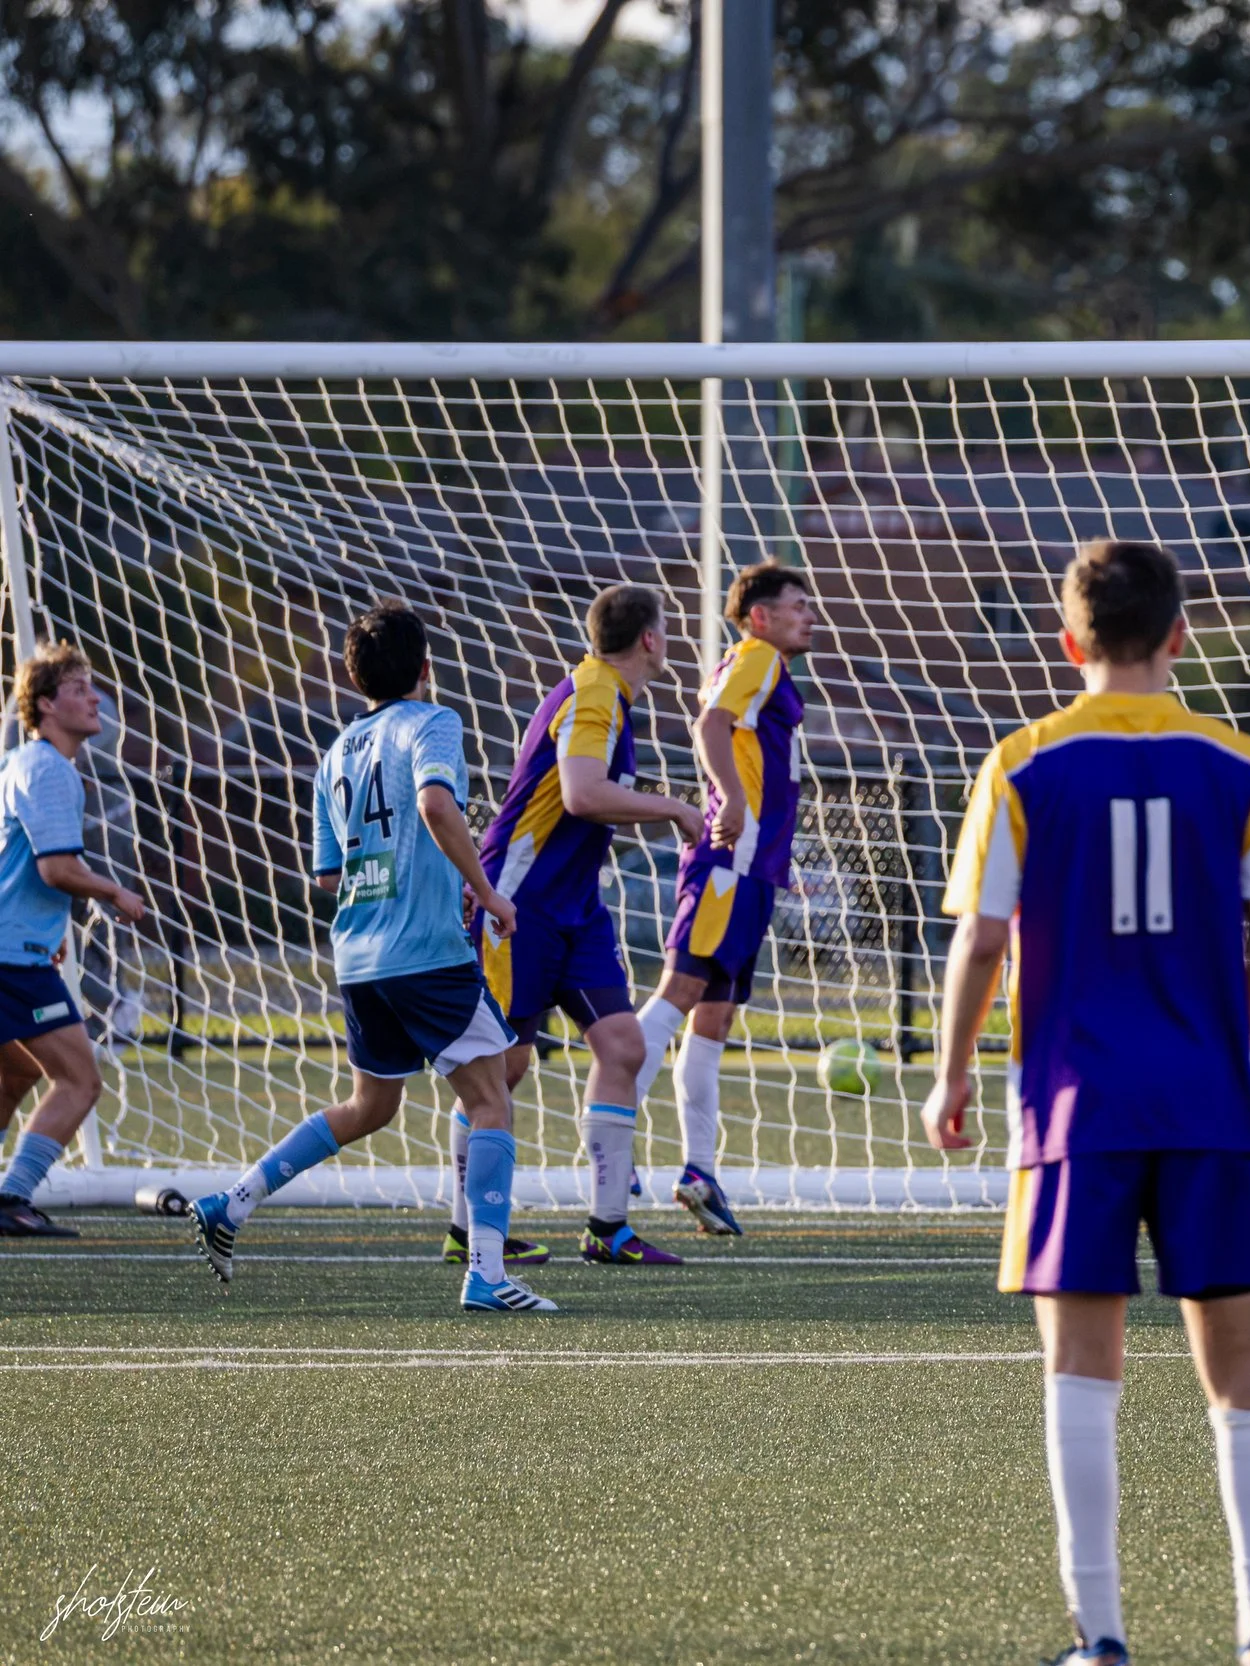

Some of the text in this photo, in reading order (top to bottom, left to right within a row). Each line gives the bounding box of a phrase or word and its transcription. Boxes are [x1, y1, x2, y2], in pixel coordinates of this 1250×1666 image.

[334, 760, 394, 847] 24
[343, 859, 390, 892] belle
[1110, 798, 1173, 934] 11
